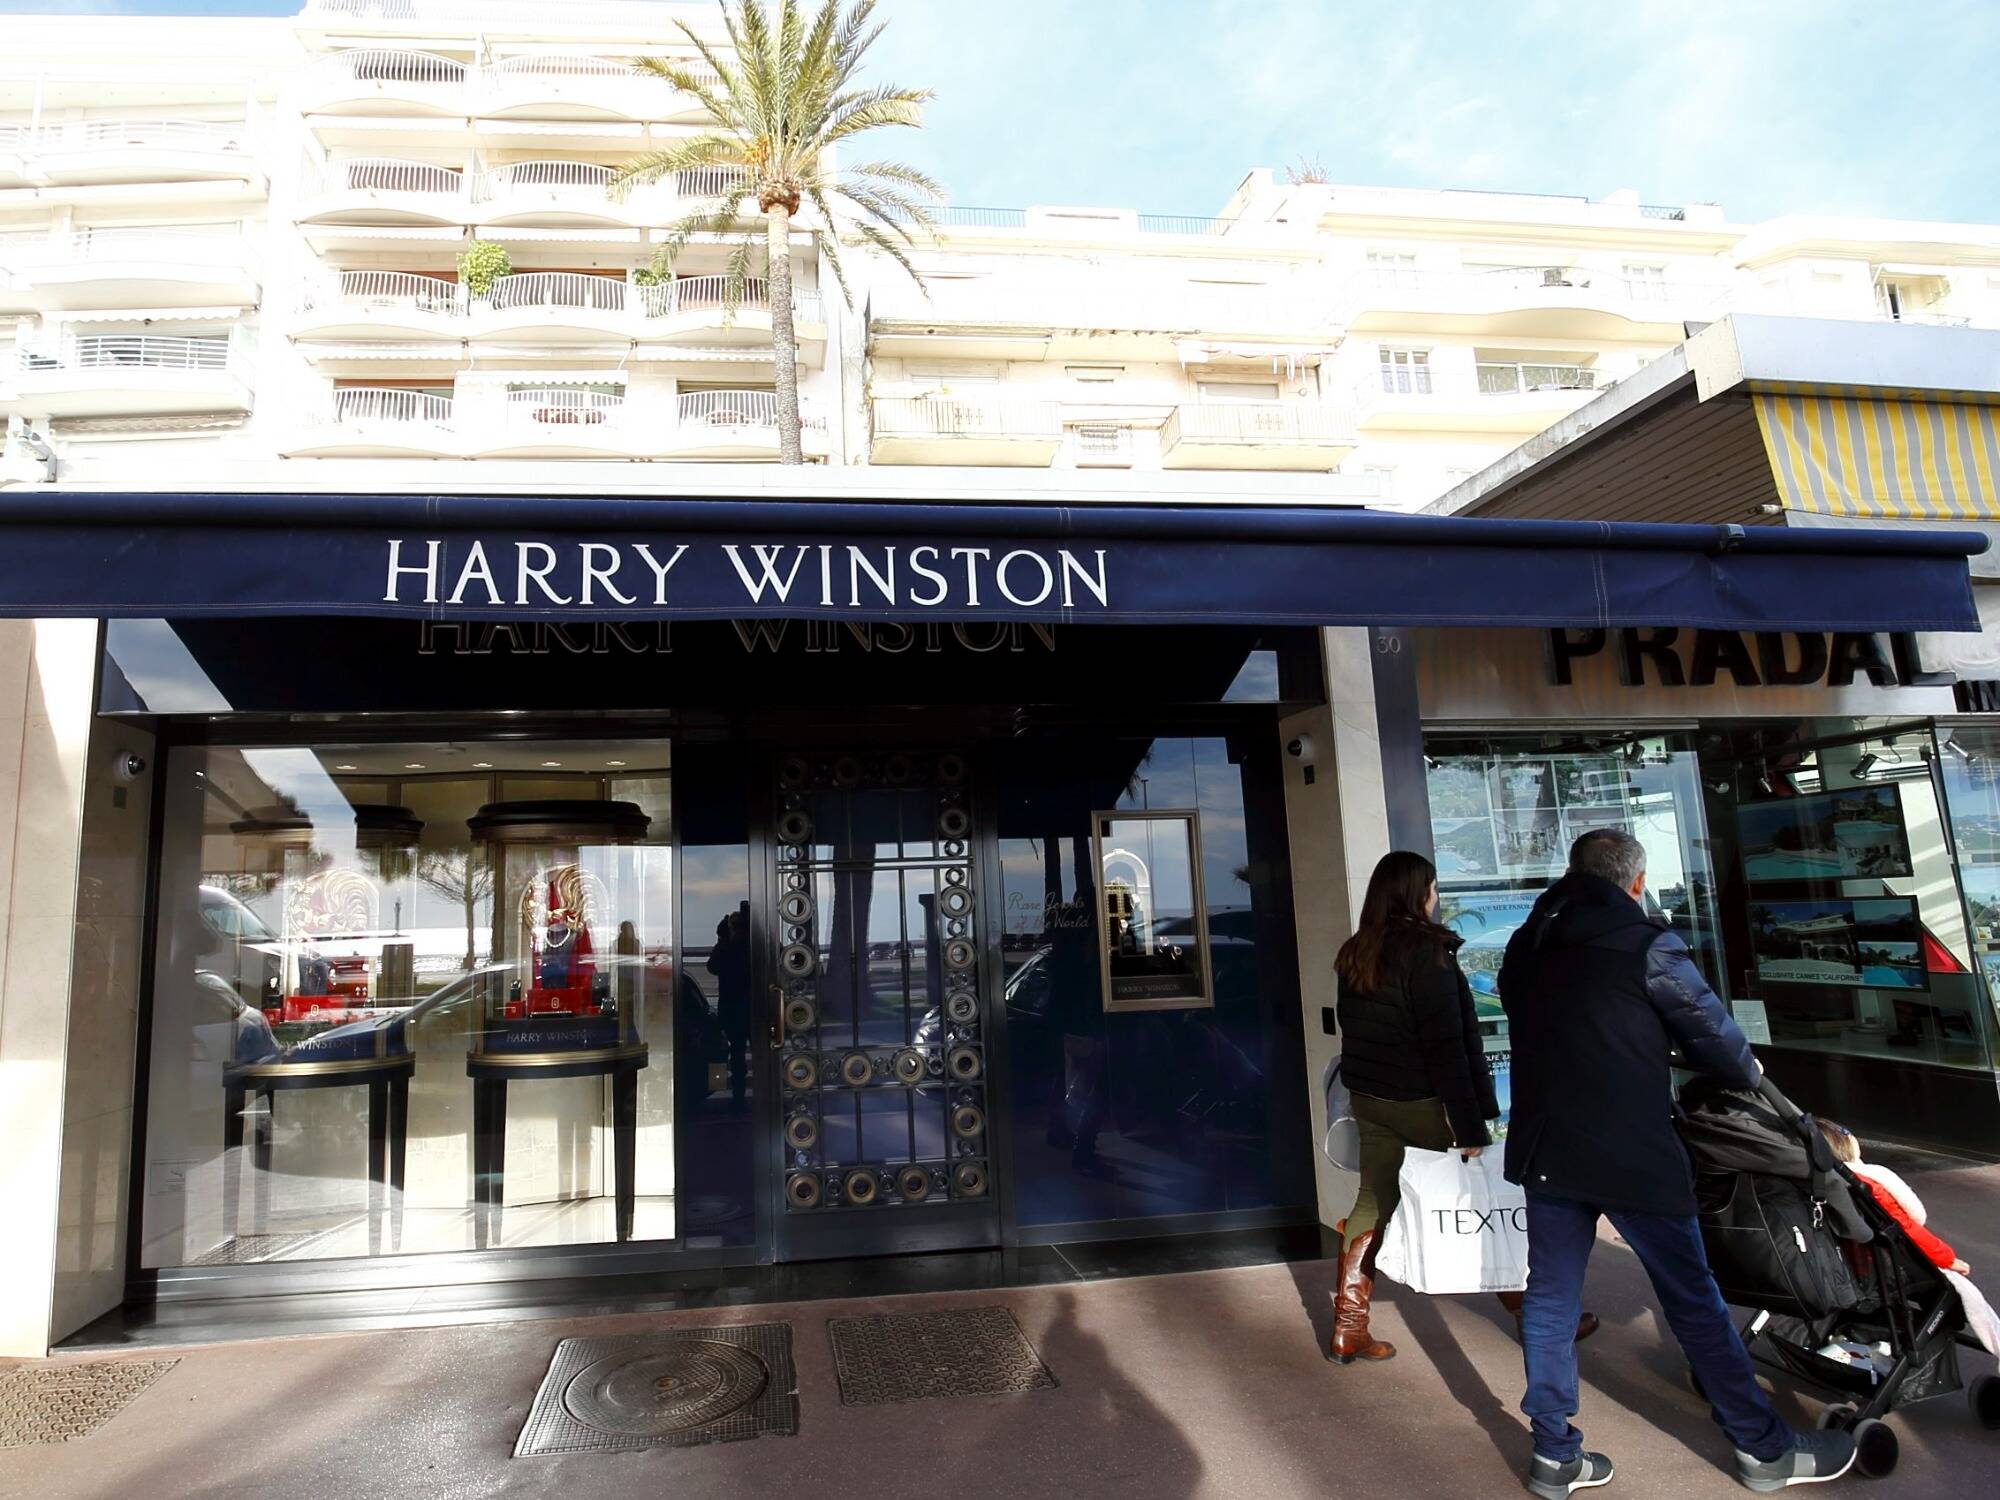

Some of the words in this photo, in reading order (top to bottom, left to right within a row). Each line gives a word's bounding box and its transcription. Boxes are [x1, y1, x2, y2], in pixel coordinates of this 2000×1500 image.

[383, 539, 690, 605] HARRY
[721, 544, 1107, 607] WINSTON
[1377, 635, 1401, 655] 30
[1548, 627, 1957, 687] PRADAL
[506, 1031, 544, 1043] HARRY
